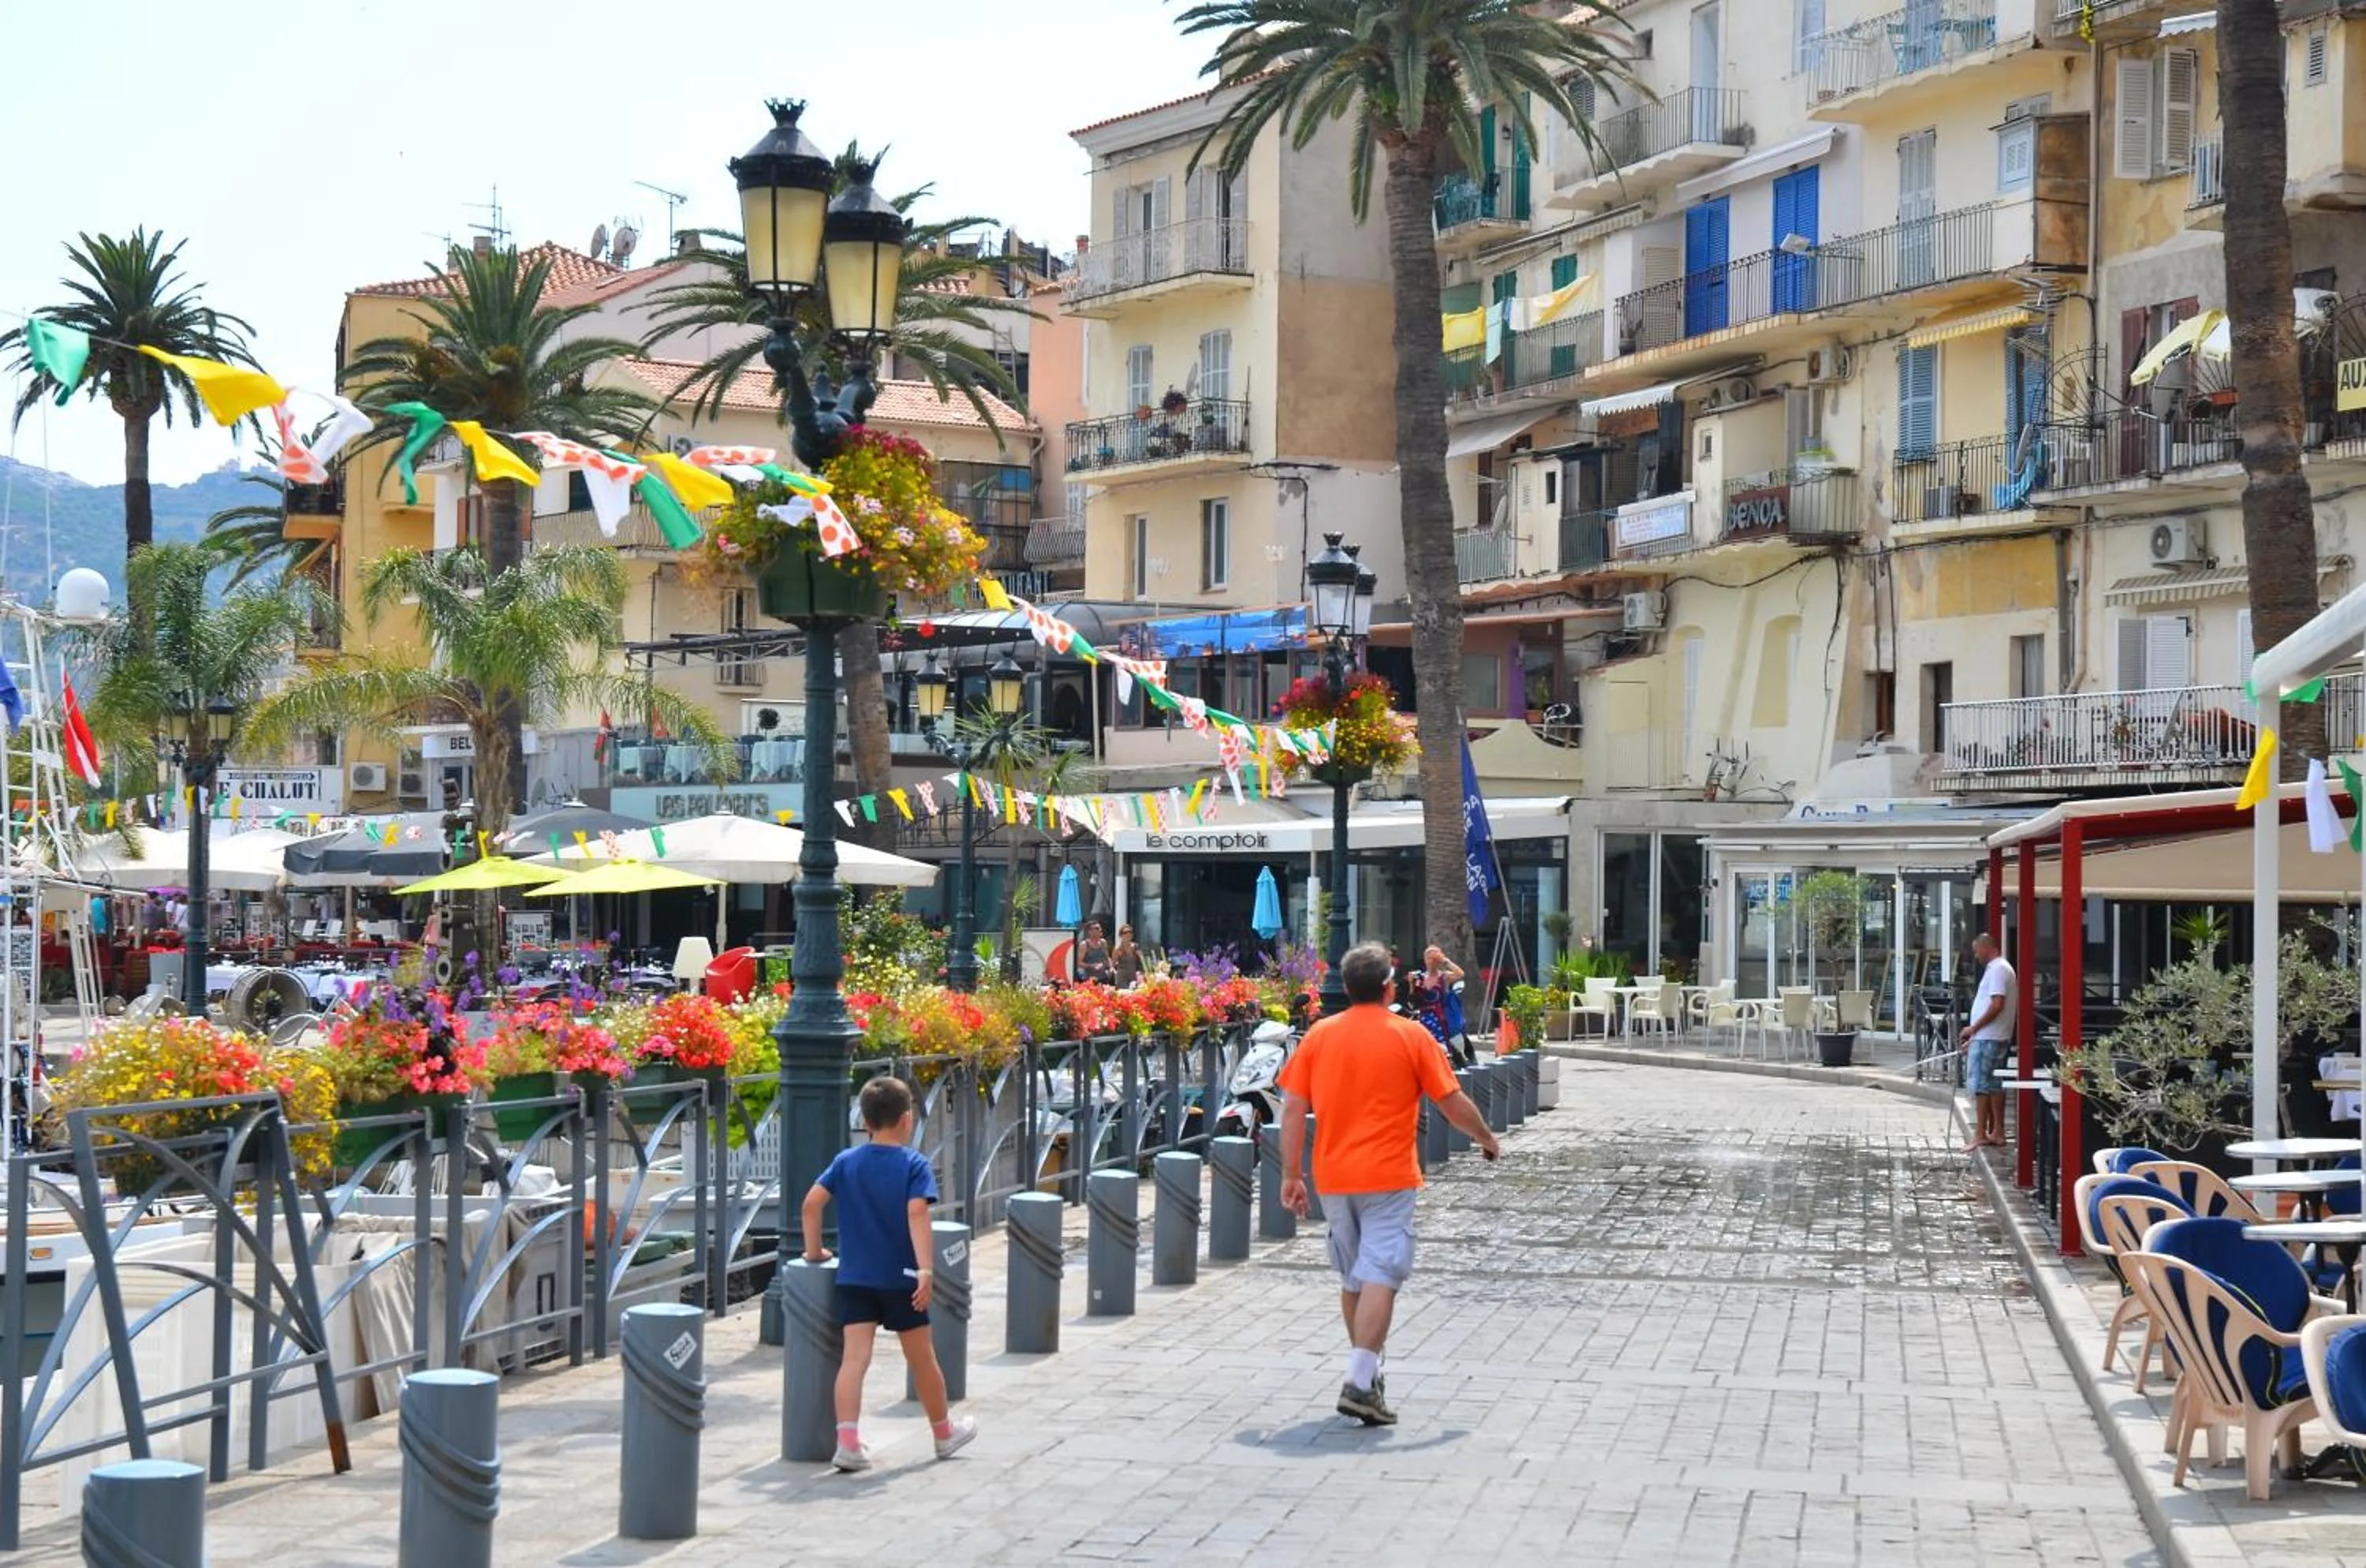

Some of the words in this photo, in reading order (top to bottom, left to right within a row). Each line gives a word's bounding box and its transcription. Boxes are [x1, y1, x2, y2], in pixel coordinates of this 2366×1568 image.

[239, 782, 317, 800] CHALUT
[1146, 832, 1162, 848] le
[1169, 831, 1269, 850] comptoir
